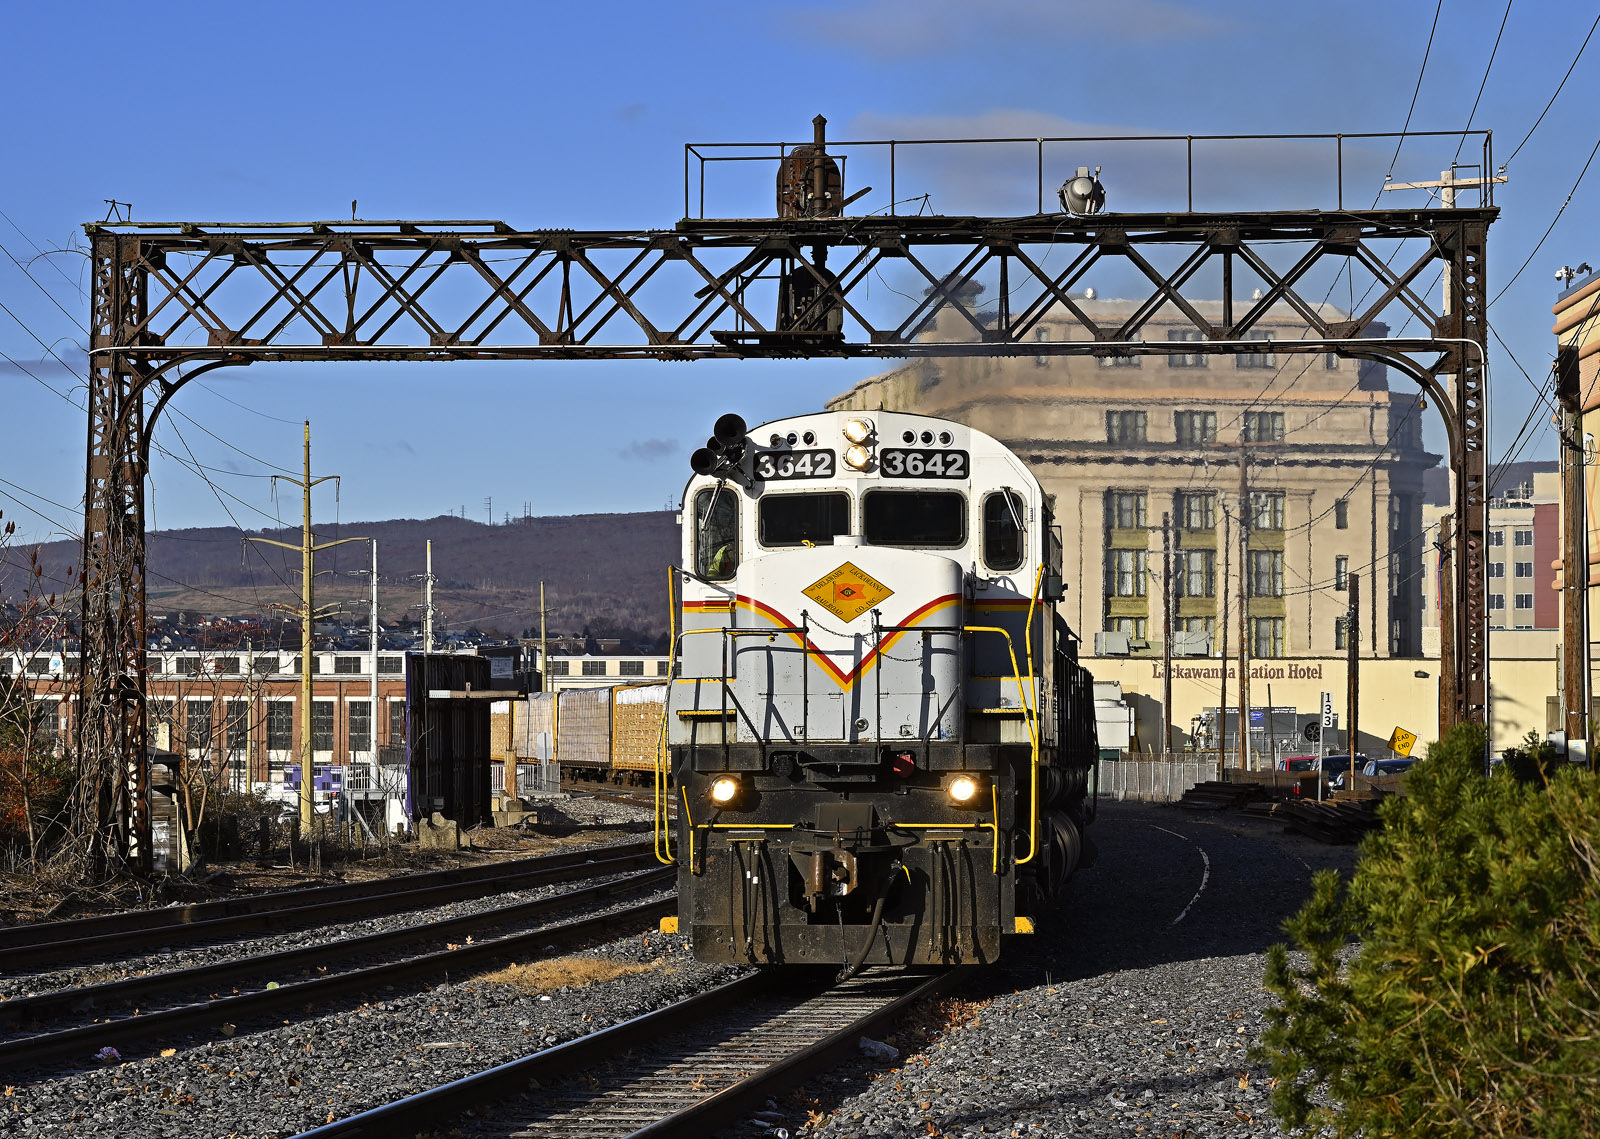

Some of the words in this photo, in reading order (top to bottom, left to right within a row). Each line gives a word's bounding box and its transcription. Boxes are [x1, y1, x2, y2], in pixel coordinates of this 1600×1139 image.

[759, 452, 832, 478] 3642
[884, 451, 965, 476] 3642
[814, 569, 845, 590] DELAWARE
[849, 567, 884, 593] LACKAWANNA
[814, 595, 844, 616] RAILROAD
[1240, 663, 1285, 679] ation
[1287, 663, 1323, 679] Hotel
[1393, 733, 1410, 743] DEAD
[1397, 741, 1410, 751] END
